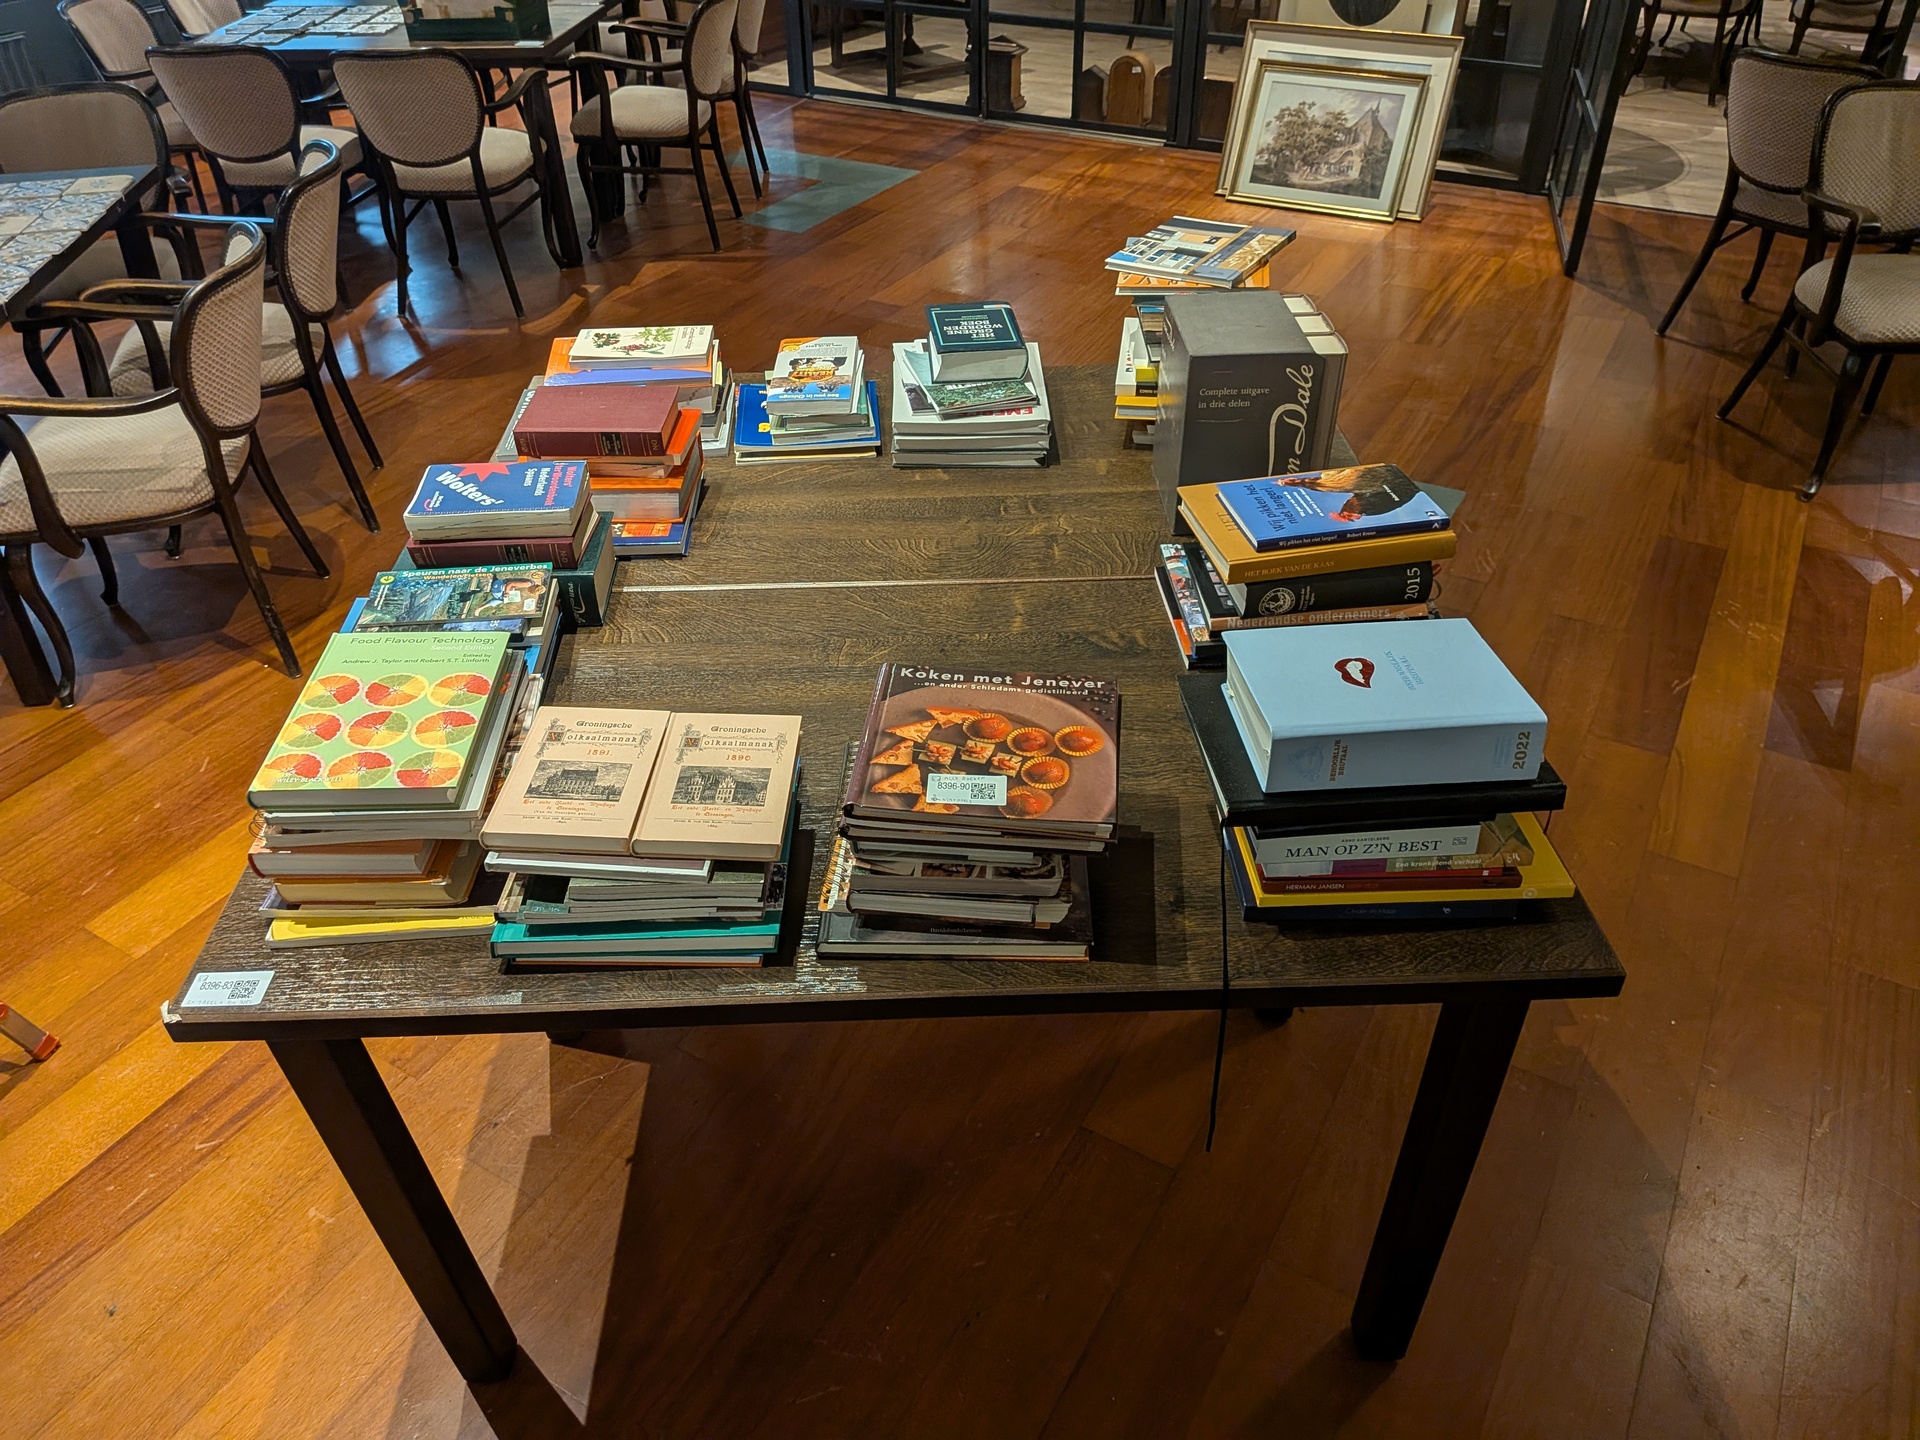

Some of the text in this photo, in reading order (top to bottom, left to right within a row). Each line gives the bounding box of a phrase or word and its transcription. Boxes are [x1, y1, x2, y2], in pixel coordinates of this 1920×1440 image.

[1199, 387, 1270, 397] Complete uitgave
[1209, 400, 1226, 408] drie
[1228, 399, 1251, 408] delen
[524, 468, 538, 487] Spaans
[435, 470, 505, 506] Wolters'
[401, 568, 446, 579] Speuren
[490, 563, 548, 572] Jeneverbes
[1244, 560, 1335, 578] HET BOEK VAN DE KAAS
[1404, 567, 1421, 600] 2015
[1226, 612, 1304, 629] Nederlandse
[1308, 607, 1391, 622] ondernemers
[384, 636, 428, 644] Flavour
[432, 636, 498, 645] Technology
[900, 667, 1106, 689] Koken met Jenever
[576, 720, 632, 728] Groningsche
[710, 726, 766, 734] Groningsche
[1512, 730, 1531, 770] 2022
[1330, 738, 1342, 782] BEHOORLIJK
[1338, 744, 1348, 776] BRUTAAL
[937, 782, 970, 790] 8396-90
[1284, 840, 1443, 858] MAN OP Z'N BEST
[1395, 858, 1482, 868] Een kronkelend verhaal
[1317, 882, 1345, 890] JANSEN
[200, 981, 234, 990] 8396-83
